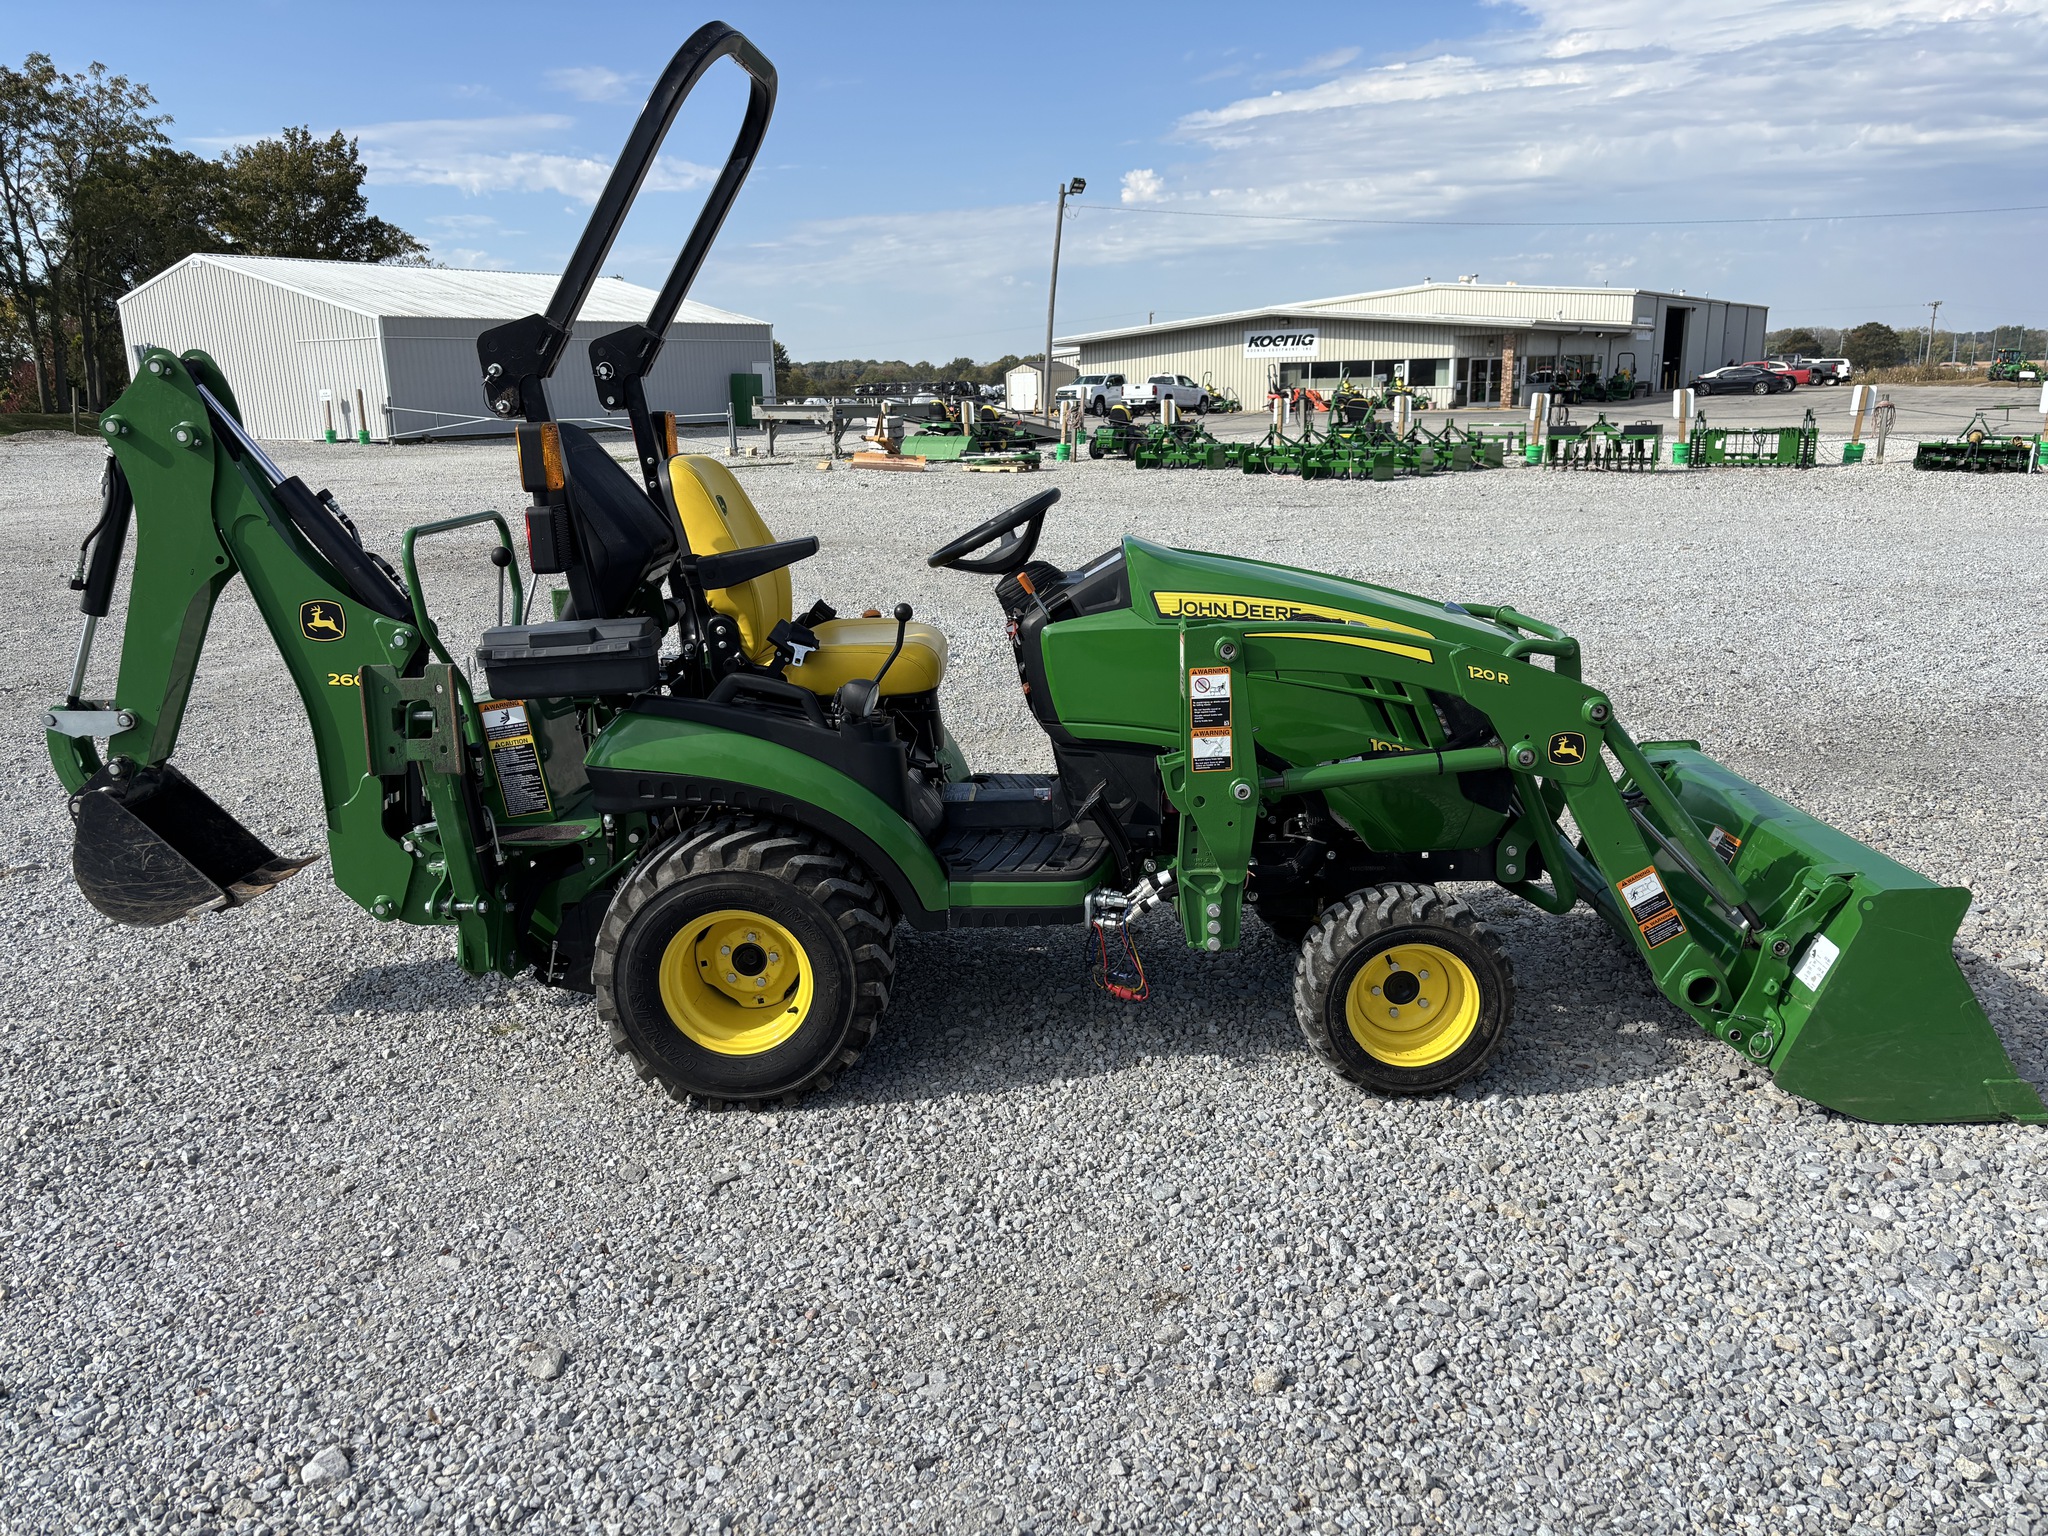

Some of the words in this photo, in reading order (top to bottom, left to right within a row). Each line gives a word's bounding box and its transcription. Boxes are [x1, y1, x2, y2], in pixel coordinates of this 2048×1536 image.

[1172, 599, 1228, 616] JOHN
[1197, 667, 1229, 675] WARNING
[488, 699, 520, 711] WARNING
[1199, 729, 1230, 737] WARNING
[500, 738, 529, 748] CAUTION
[1370, 738, 1414, 752] 102
[1626, 869, 1651, 884] WARNING
[1649, 911, 1674, 926] WARNING
